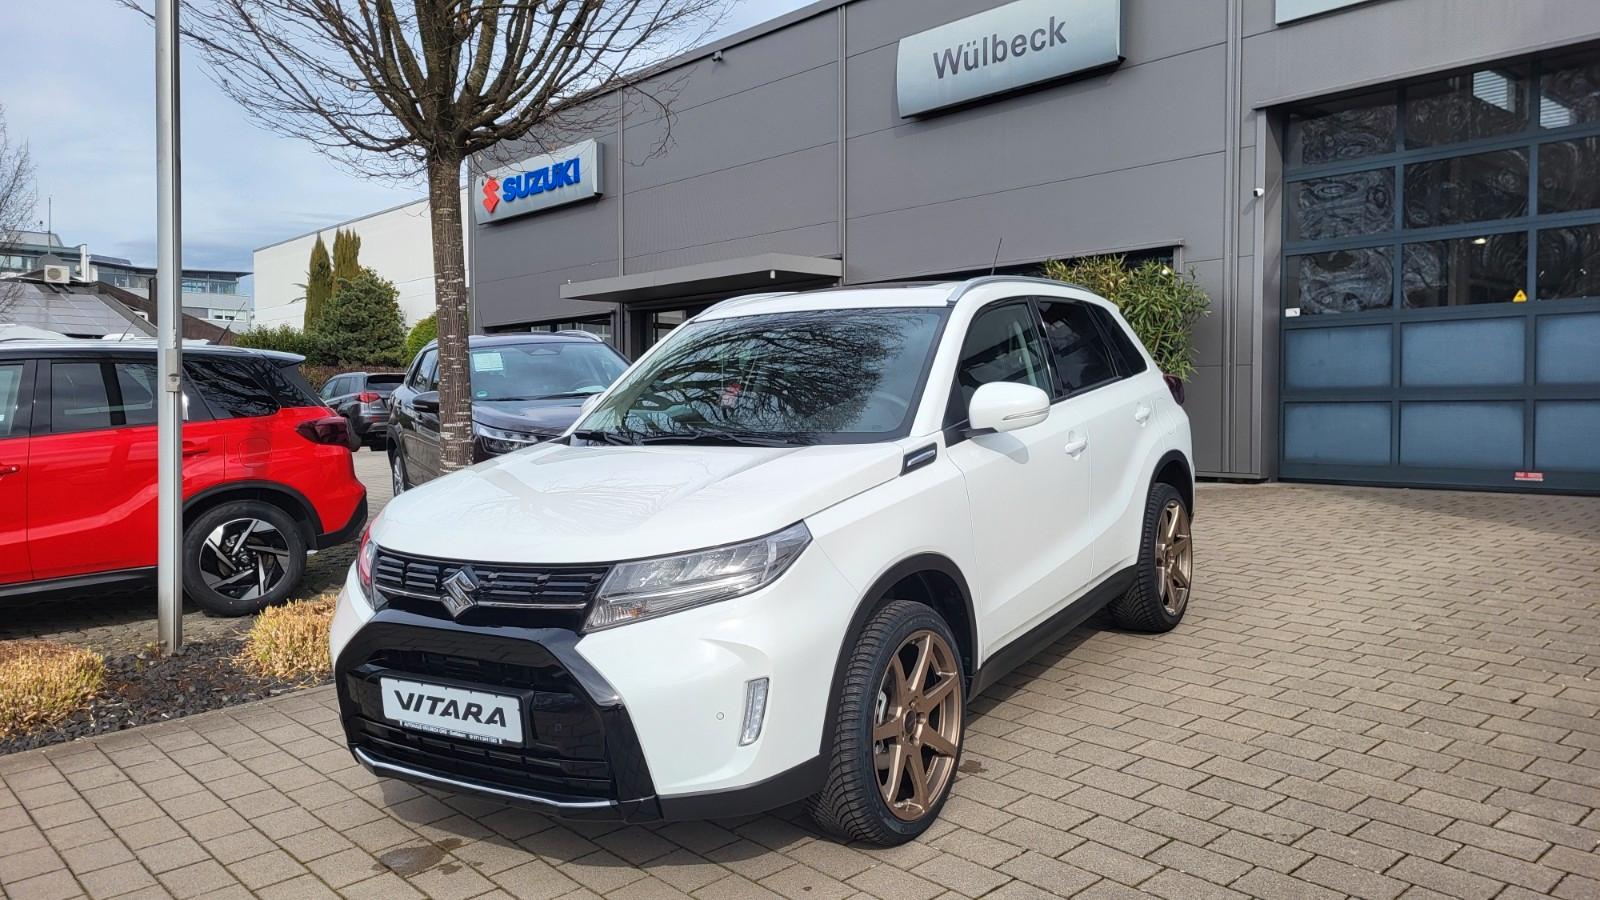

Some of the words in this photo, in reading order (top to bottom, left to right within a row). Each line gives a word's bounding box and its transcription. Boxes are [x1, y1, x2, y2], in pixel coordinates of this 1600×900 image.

[933, 16, 1067, 79] Wülbeck
[502, 157, 580, 203] SUZUKI
[393, 690, 507, 728] VITARA
